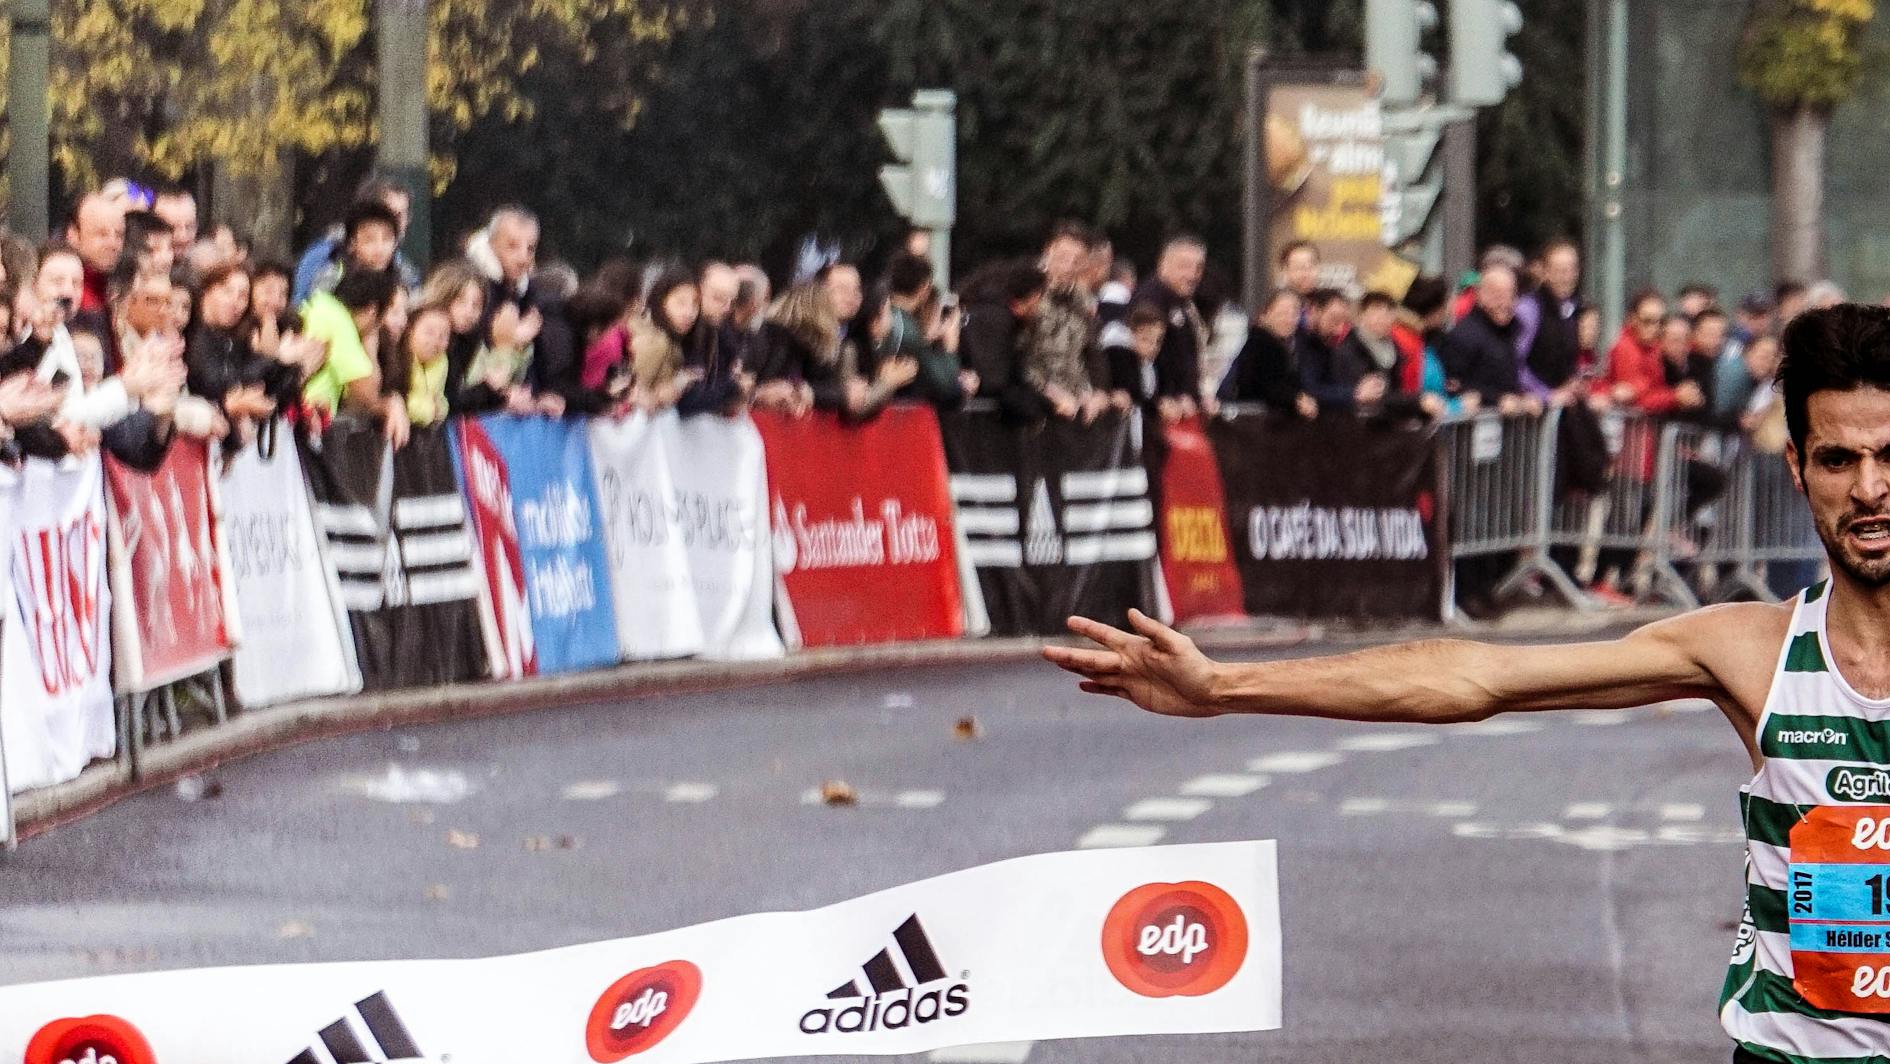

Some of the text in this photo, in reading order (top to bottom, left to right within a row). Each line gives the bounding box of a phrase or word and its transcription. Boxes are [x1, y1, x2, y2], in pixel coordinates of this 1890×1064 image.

[794, 496, 940, 570] Santander Totta
[1379, 507, 1428, 560] VIDA
[1778, 728, 1848, 746] macron
[1794, 871, 1813, 914] 2017
[1137, 914, 1209, 964] edp
[1826, 930, 1880, 948] Hélder
[610, 986, 668, 1029] edp
[799, 981, 971, 1035] adidas
